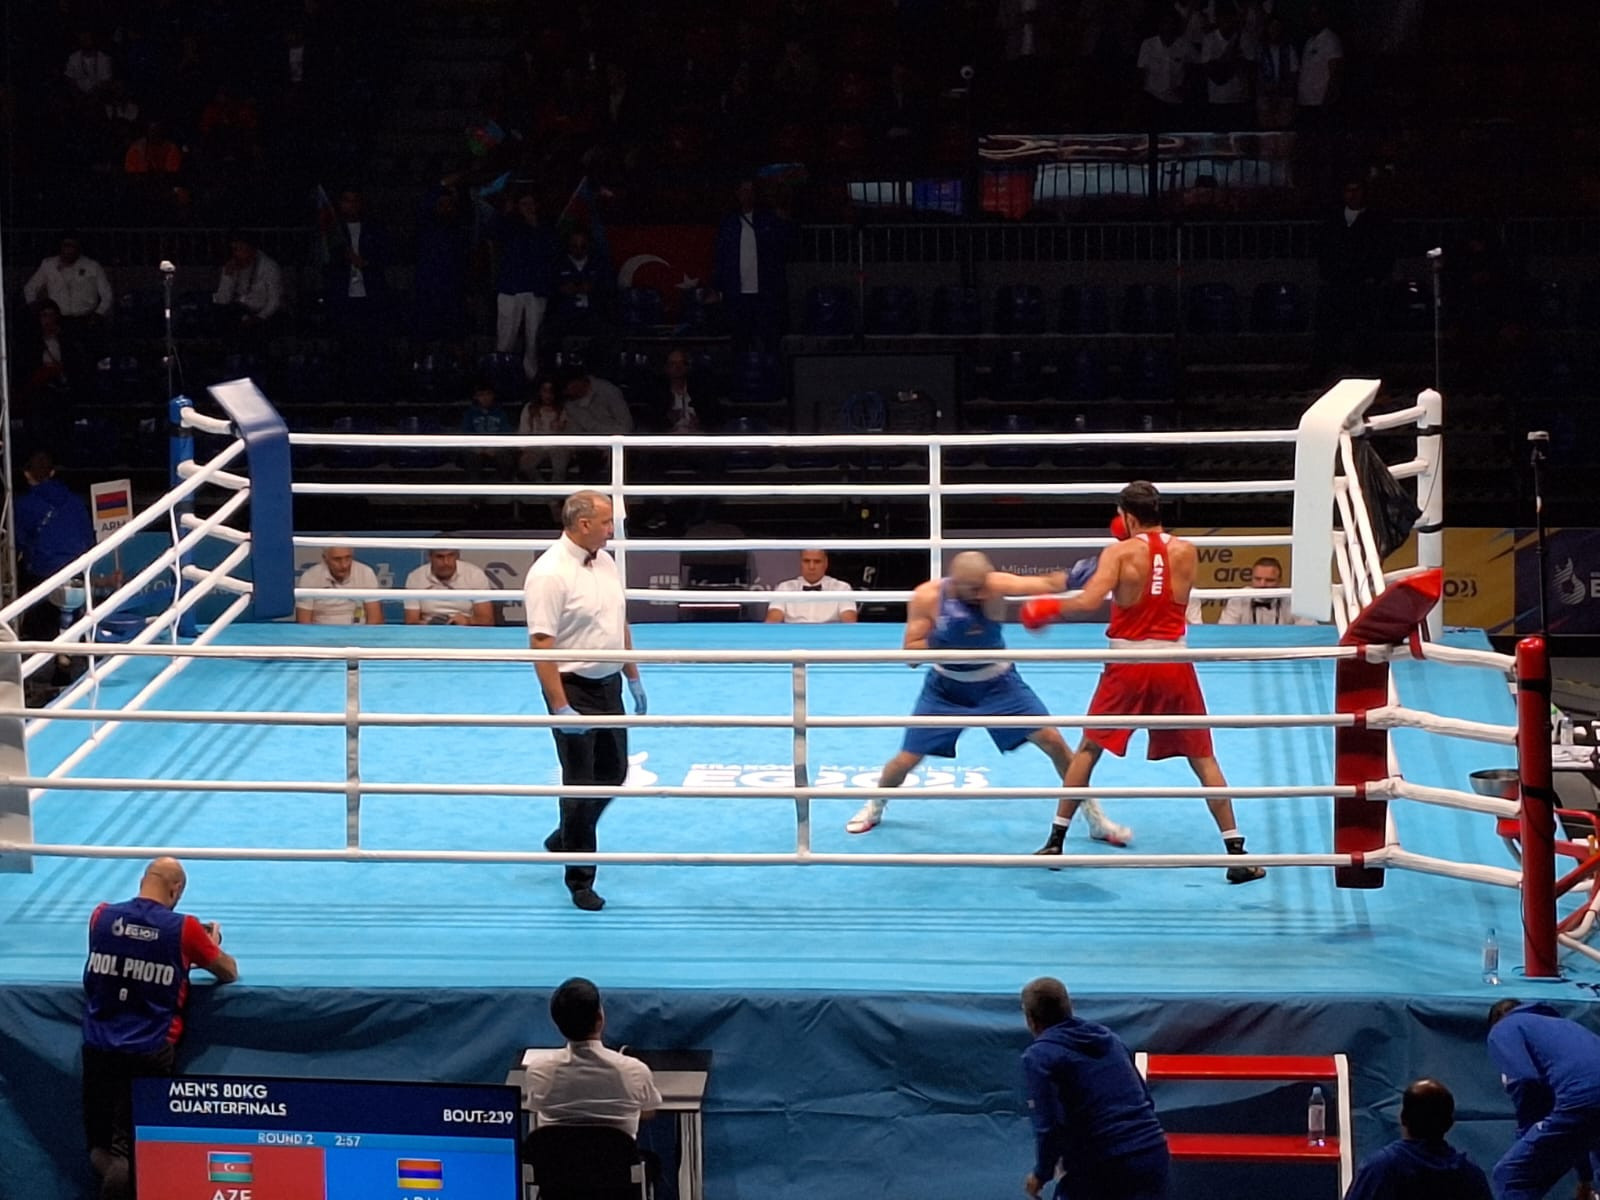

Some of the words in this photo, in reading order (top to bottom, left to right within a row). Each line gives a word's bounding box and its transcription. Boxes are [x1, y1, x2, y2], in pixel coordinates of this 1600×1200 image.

[1197, 548, 1232, 563] we
[1151, 554, 1164, 595] AZE
[1214, 567, 1253, 582] are
[122, 957, 174, 986] PHOTO
[169, 1082, 219, 1097] MEN'S
[223, 1083, 268, 1099] 80KG
[169, 1100, 287, 1115] QUARTERFINALS
[443, 1109, 514, 1124] BOUT:239
[257, 1132, 303, 1144] ROUND
[306, 1134, 315, 1145] 2
[334, 1135, 361, 1147] 2:57
